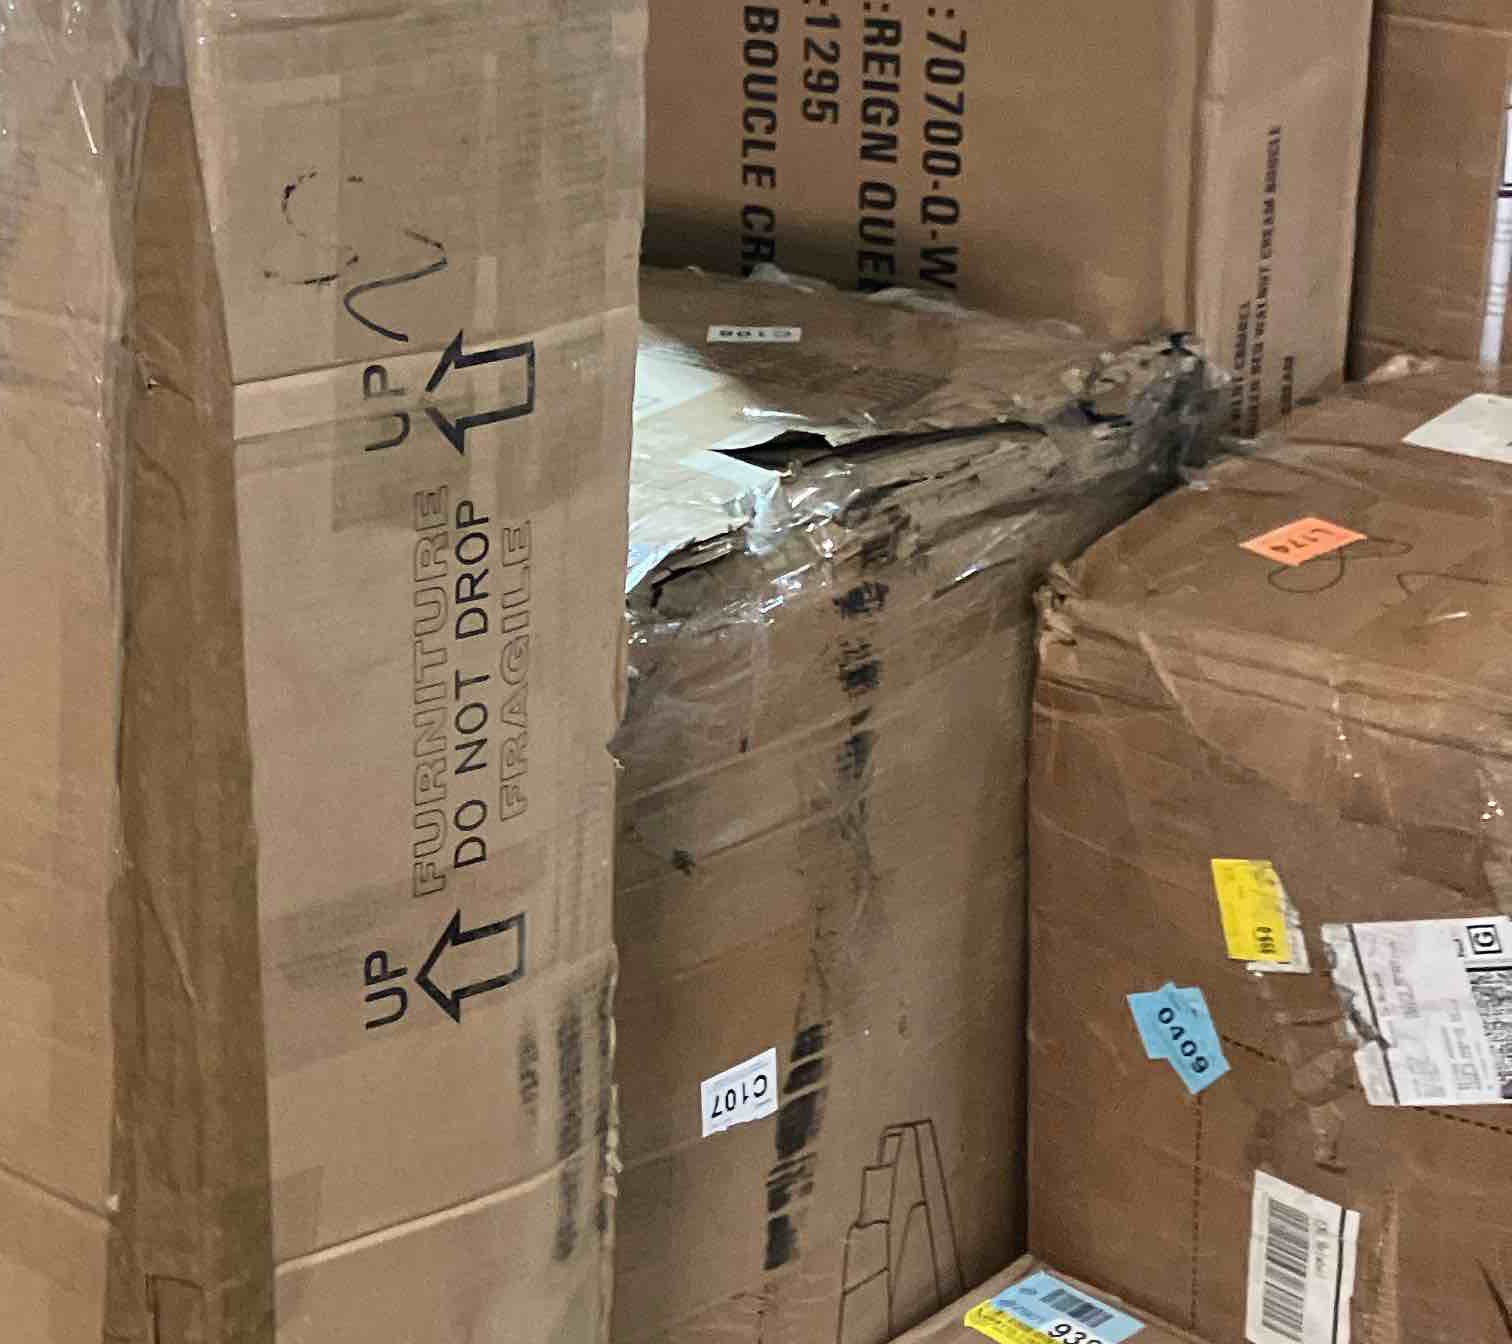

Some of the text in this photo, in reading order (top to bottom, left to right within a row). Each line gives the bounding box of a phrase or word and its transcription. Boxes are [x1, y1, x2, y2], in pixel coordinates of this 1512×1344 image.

[858, 0, 903, 164] :REIGN
[363, 364, 412, 452] UP
[412, 485, 448, 897] FURNITURE
[454, 499, 490, 868] DO NOT DROP
[500, 520, 532, 820] FRAGILE
[364, 949, 409, 1030] UP
[711, 1075, 768, 1118] C107
